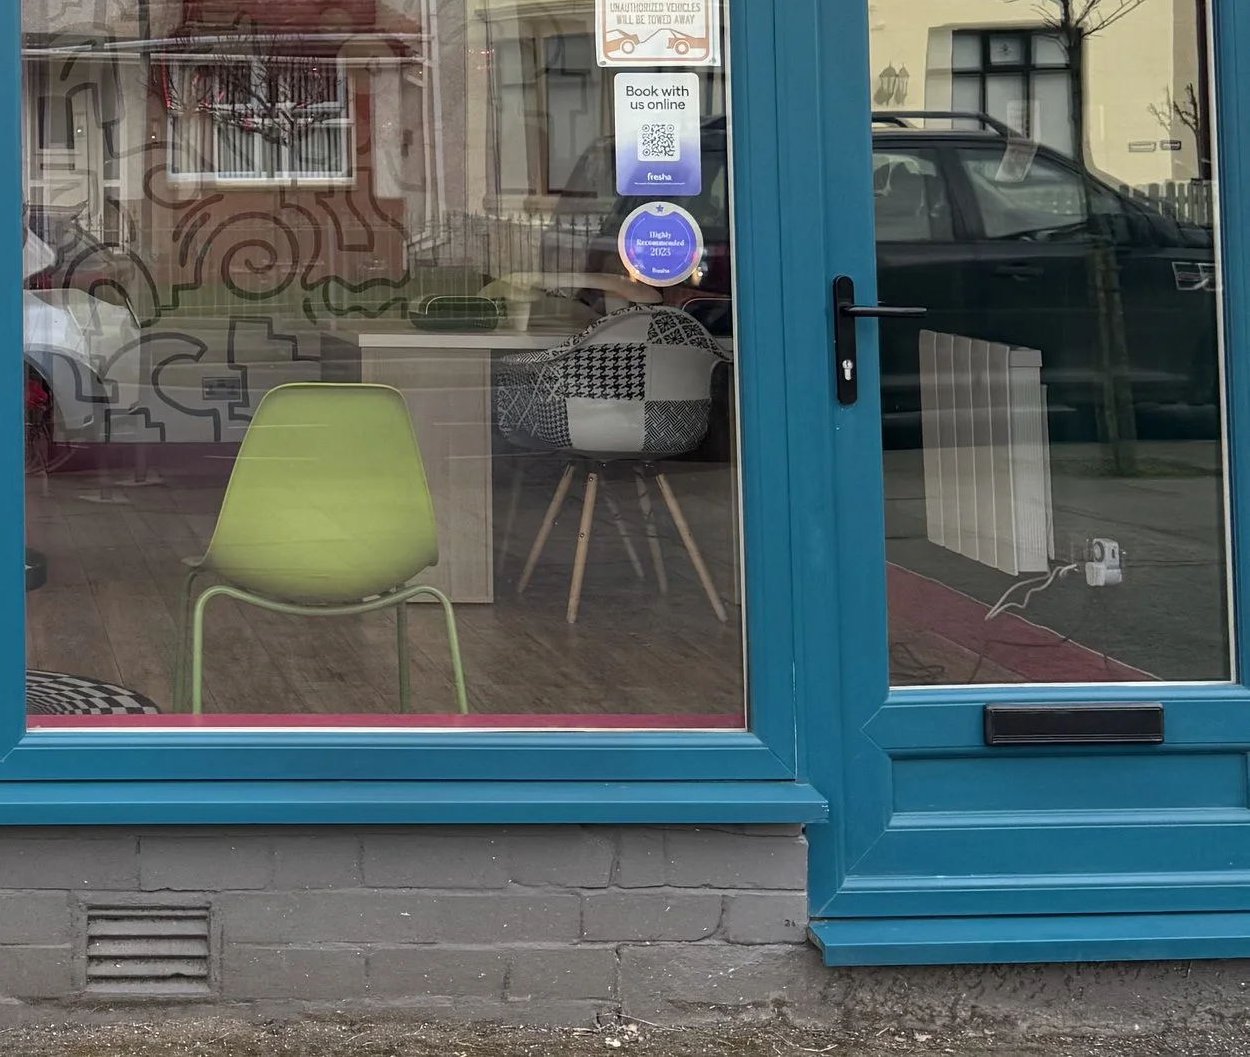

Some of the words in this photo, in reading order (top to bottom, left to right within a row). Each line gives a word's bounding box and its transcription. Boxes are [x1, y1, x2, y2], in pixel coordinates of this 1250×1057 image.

[610, 2, 663, 12] UNAUTHORIZED
[666, 2, 701, 12] VEHICLES
[616, 15, 634, 24] WILL
[636, 15, 646, 24] BE
[648, 15, 672, 24] TOWED
[674, 14, 695, 24] AWAY
[626, 86, 658, 96] Book
[661, 85, 689, 96] with
[630, 101, 644, 110] us
[647, 98, 685, 110] online
[647, 172, 672, 181] fresha
[649, 231, 671, 239] Highly
[650, 248, 671, 256] 2023
